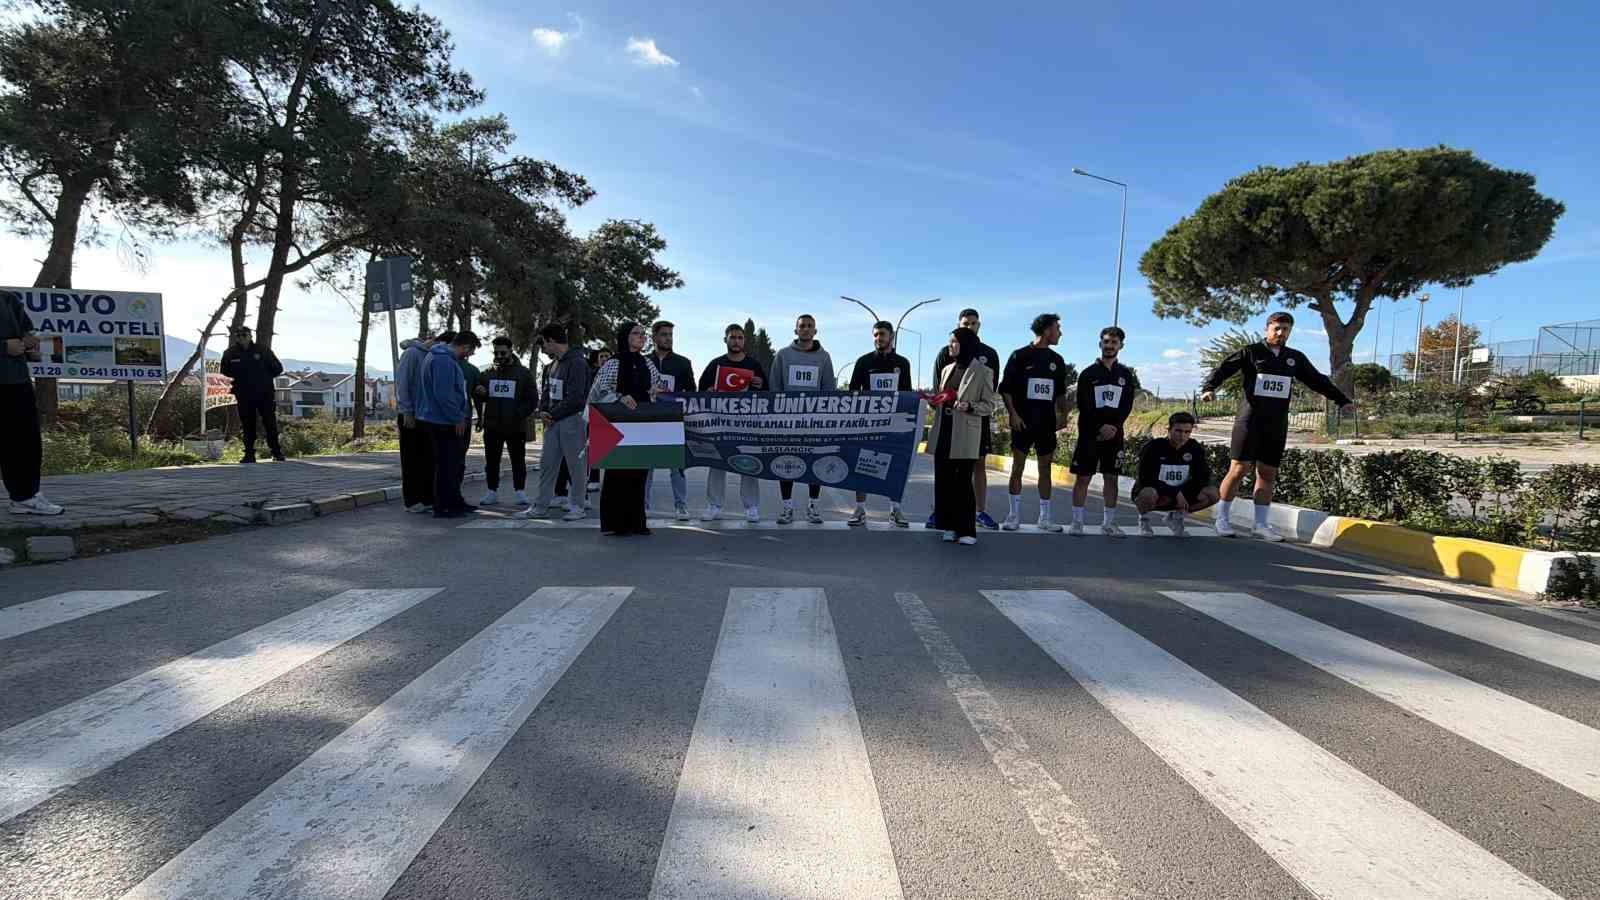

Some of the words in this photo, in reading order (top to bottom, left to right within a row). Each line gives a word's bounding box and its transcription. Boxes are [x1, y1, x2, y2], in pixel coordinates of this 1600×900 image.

[34, 319, 92, 334] AMA
[1263, 380, 1284, 392] 035
[774, 391, 899, 414] ÜNİVERSİTESİ
[794, 417, 838, 429] BİLİMLER
[839, 416, 892, 429] FAKÜLTESİ
